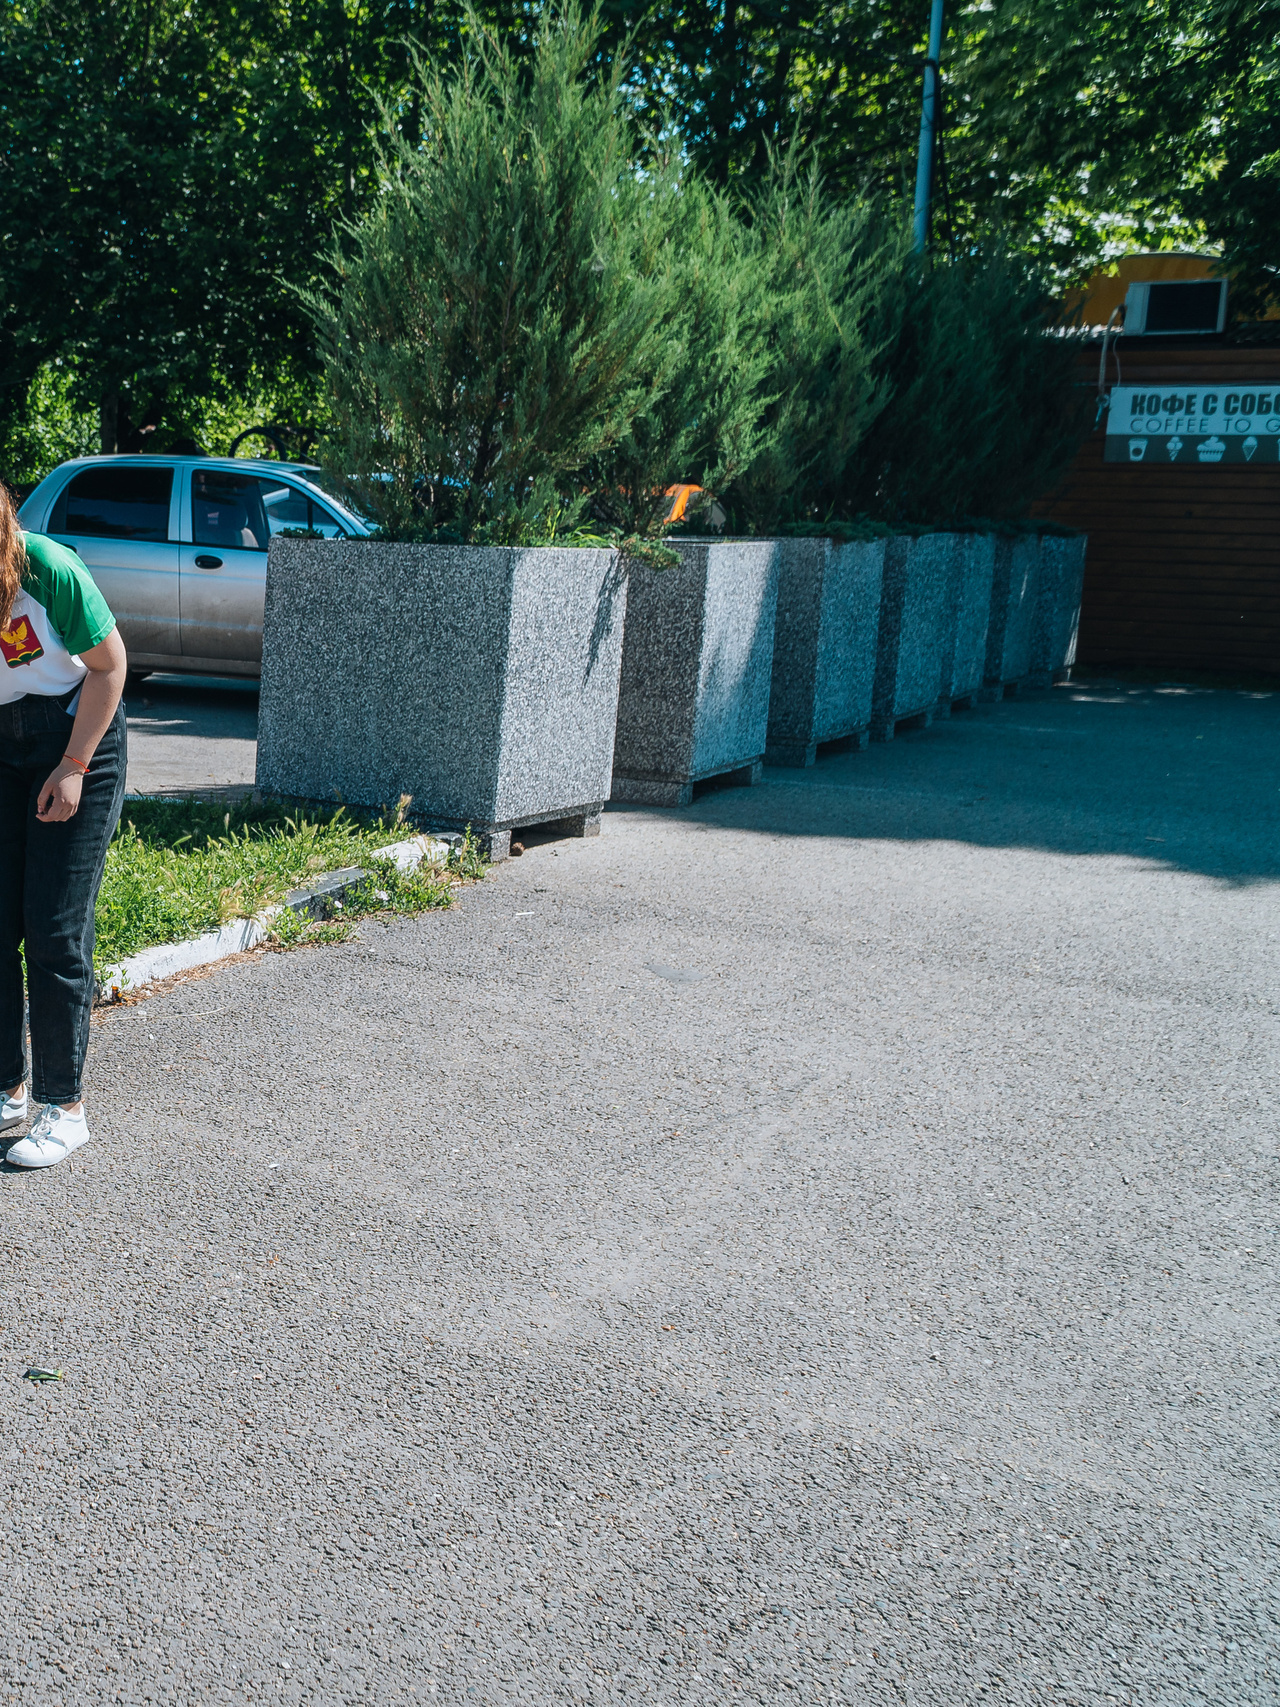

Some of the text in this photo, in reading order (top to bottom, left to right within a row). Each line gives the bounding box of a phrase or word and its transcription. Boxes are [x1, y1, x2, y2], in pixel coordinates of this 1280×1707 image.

[1130, 393, 1197, 416] КОФЕ
[1202, 393, 1219, 416] С
[1130, 418, 1209, 433] COFFEE
[1223, 418, 1252, 433] TO
